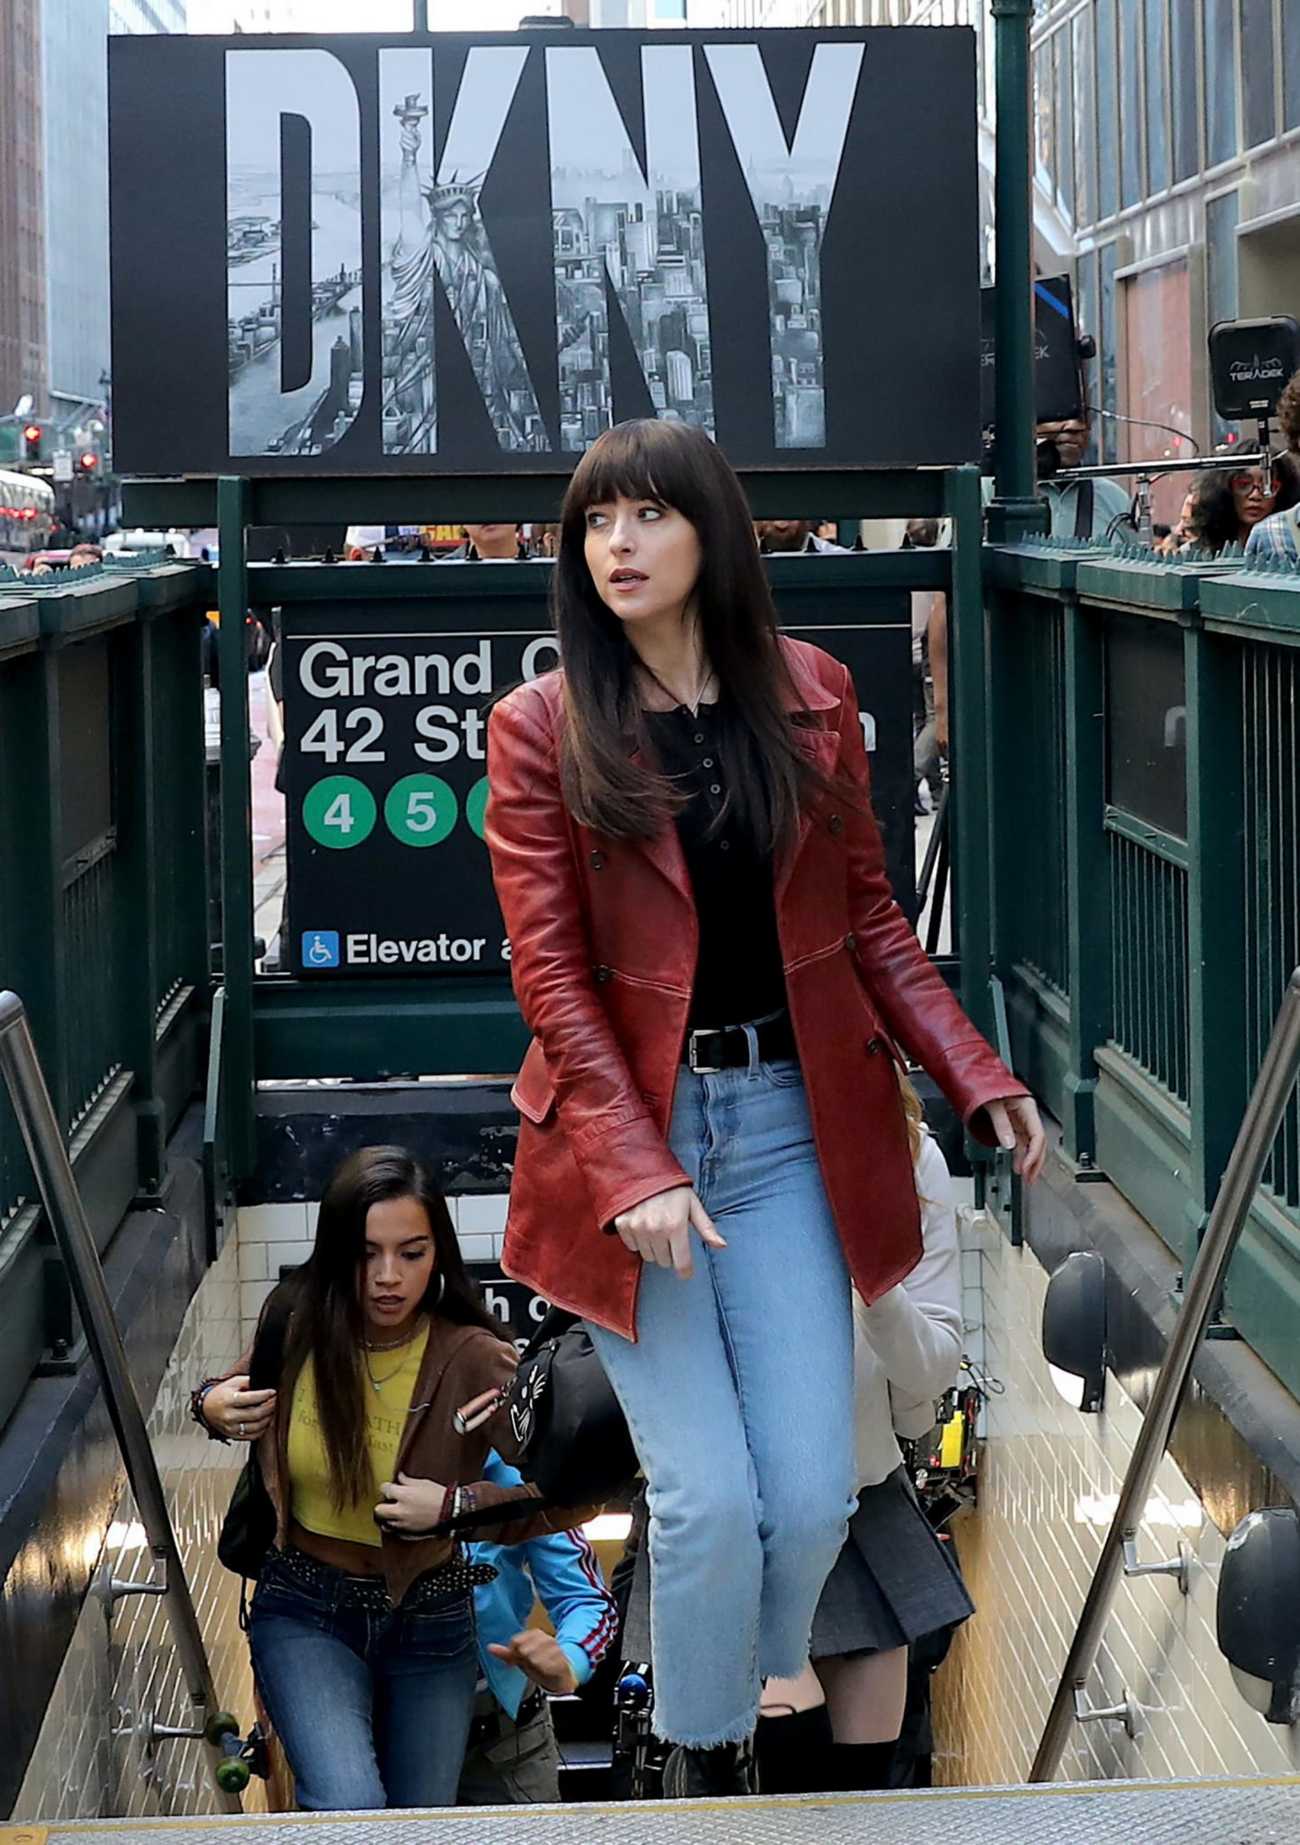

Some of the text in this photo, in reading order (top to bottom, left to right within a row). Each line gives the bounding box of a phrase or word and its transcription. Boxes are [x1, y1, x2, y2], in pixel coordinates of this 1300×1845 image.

[225, 42, 867, 457] DKNY
[299, 639, 492, 698] Grand
[301, 708, 385, 762] 42
[323, 792, 436, 833] 4 5
[347, 934, 485, 963] Elevator
